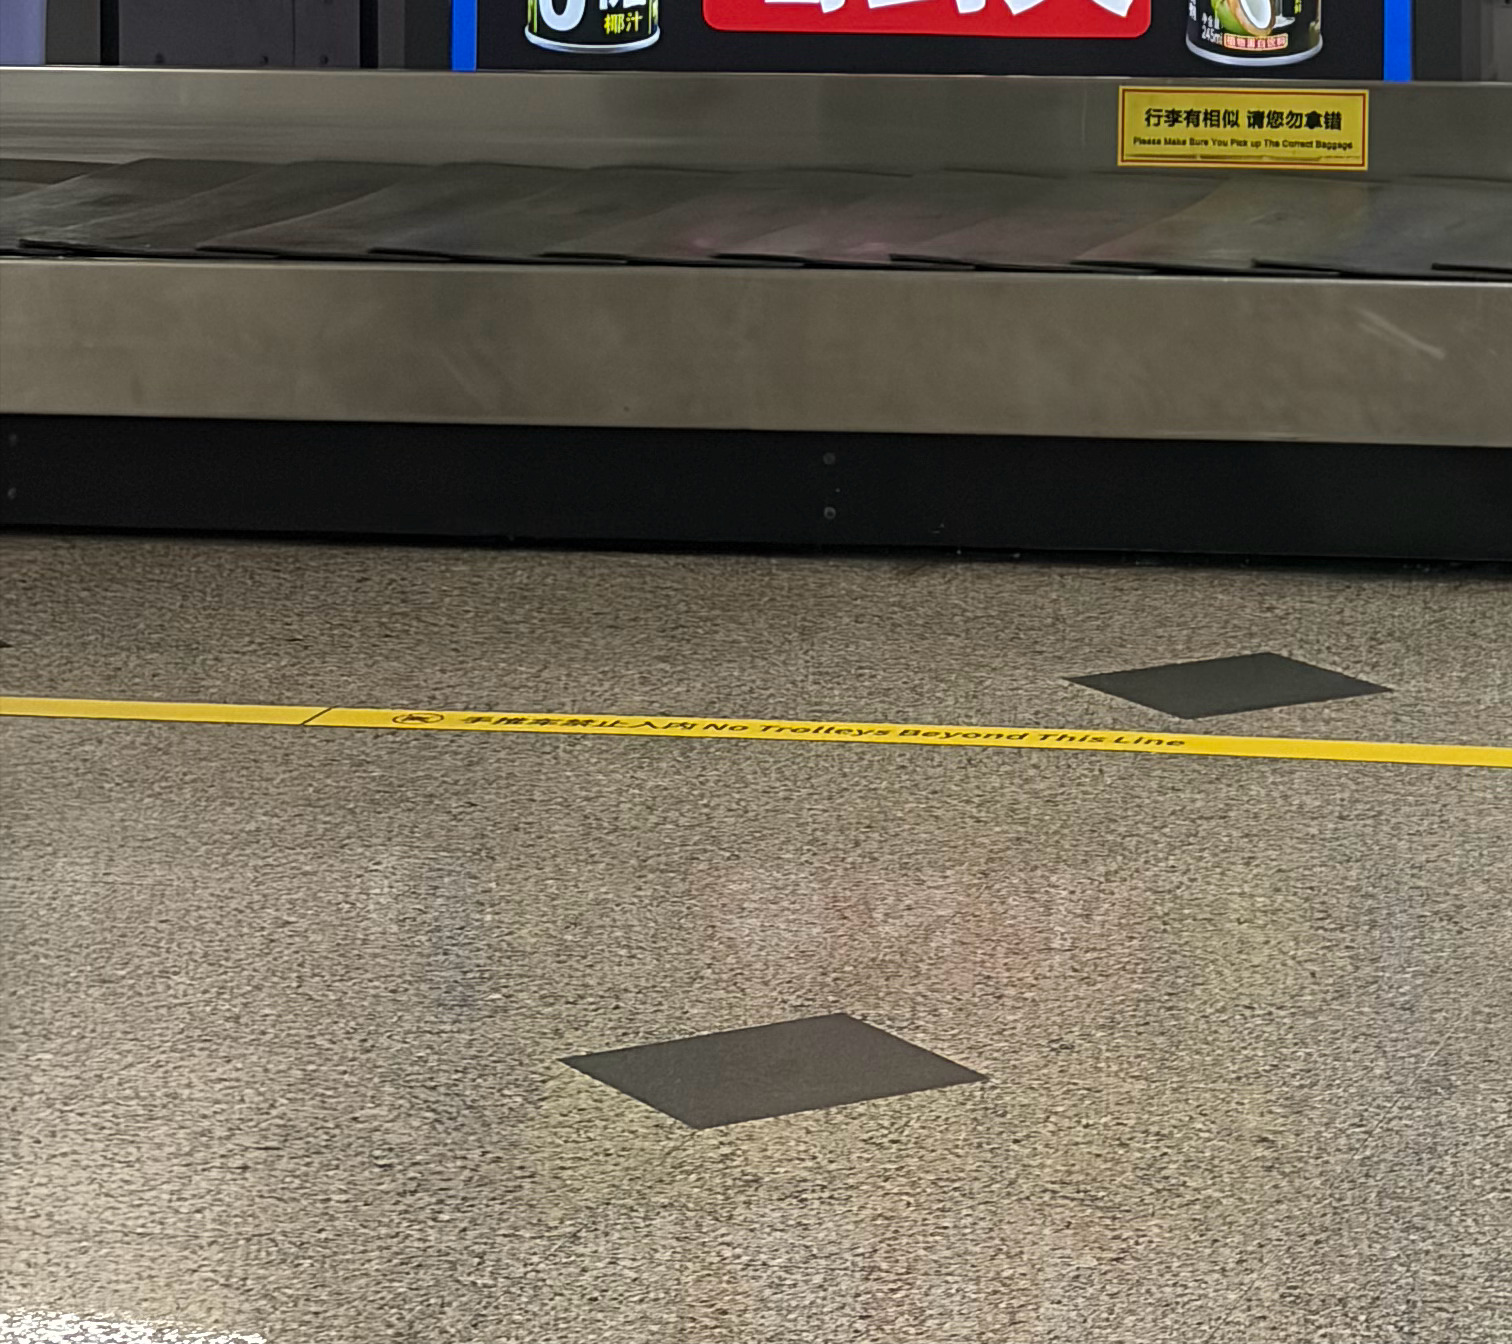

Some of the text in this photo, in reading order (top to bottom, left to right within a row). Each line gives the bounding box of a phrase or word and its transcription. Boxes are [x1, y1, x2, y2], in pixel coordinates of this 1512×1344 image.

[603, 10, 643, 35] 椰汁
[1144, 108, 1342, 131] 行李有相似 请您勿拿错
[1133, 136, 1162, 146] Please
[1210, 138, 1229, 147] You
[1230, 138, 1248, 147] Pick
[1250, 139, 1262, 149] up
[1263, 138, 1281, 148] The
[703, 723, 748, 732] No
[759, 725, 890, 737] Trolleys
[898, 729, 1028, 741] Beyond
[1037, 733, 1103, 743] This
[1113, 737, 1185, 747] Line
